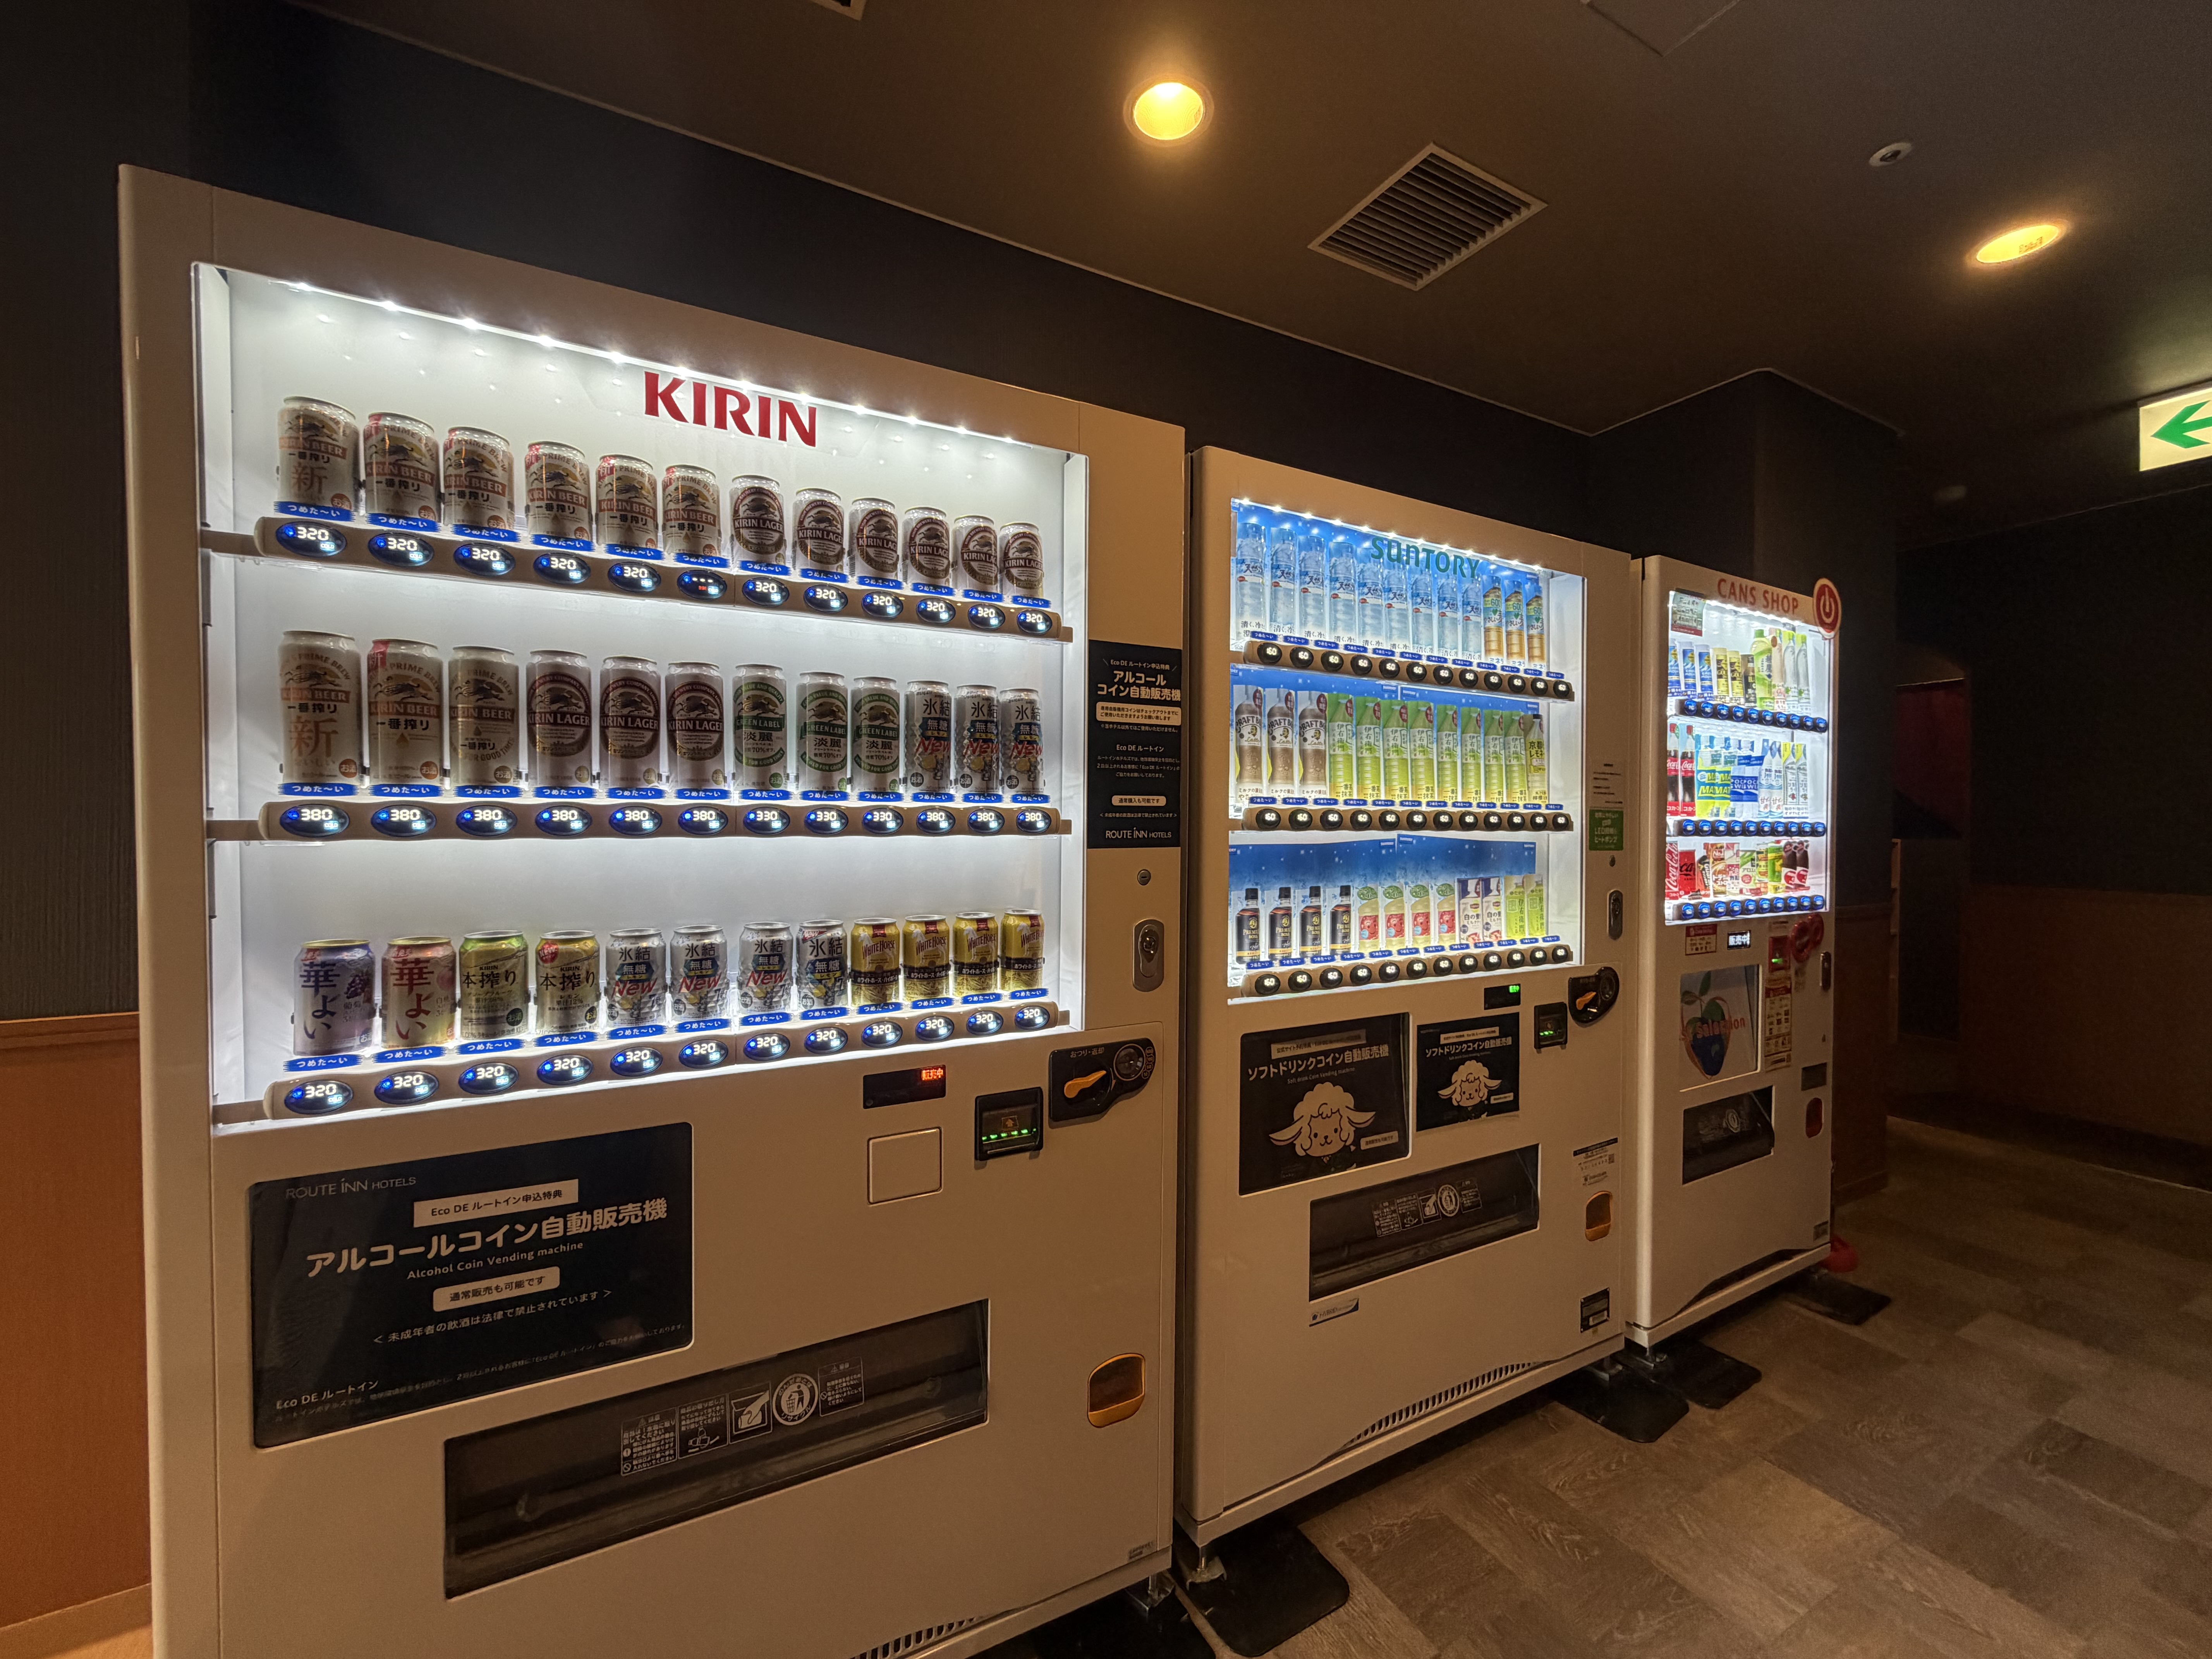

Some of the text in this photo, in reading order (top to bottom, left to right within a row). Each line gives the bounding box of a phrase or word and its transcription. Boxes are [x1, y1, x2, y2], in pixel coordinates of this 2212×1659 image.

[644, 371, 817, 447] KIRIN
[313, 441, 343, 456] BEER
[402, 467, 431, 483] BEER
[559, 493, 585, 505] BEER
[690, 513, 714, 523] BEER
[735, 518, 783, 532] KIRIN LAGER
[297, 527, 329, 541] 320
[388, 538, 417, 551] 320
[472, 548, 501, 560] 320
[551, 557, 577, 570] 320
[756, 582, 777, 594] 320
[873, 594, 892, 606] 320
[1717, 579, 1798, 615] CANS SHOP
[1027, 613, 1043, 623] 320
[1113, 671, 1166, 685] アルコール
[1097, 684, 1181, 701] コイン自動販売機
[407, 704, 437, 715] BEER
[483, 709, 511, 719] BEER
[923, 699, 950, 717] 氷結
[376, 719, 429, 730] 一番搾り
[557, 714, 589, 725] LAGER
[927, 720, 948, 730] 無糖
[744, 732, 773, 742] 淡麗
[814, 738, 841, 747] 淡麗
[915, 737, 951, 754] New
[301, 809, 333, 821] 380
[391, 809, 421, 821] 380
[552, 810, 578, 821] 380
[625, 810, 649, 821] 380
[757, 811, 780, 821] 330
[817, 811, 837, 822] 330
[927, 811, 946, 822] 380
[1025, 812, 1042, 822] 380
[809, 938, 843, 957] 氷結
[862, 940, 895, 959] WHITE HORSE
[915, 936, 946, 955] WHITE HORSE
[619, 946, 650, 962] 氷結
[623, 965, 646, 974] 無糖
[815, 960, 840, 972] 無糖
[463, 970, 516, 988] 本搾り
[540, 971, 595, 991] 本搾り
[611, 977, 658, 998] New
[976, 1013, 993, 1024] 320
[1024, 1009, 1040, 1018] 320
[871, 1024, 892, 1035] 320
[757, 1036, 778, 1048] 320
[693, 1043, 716, 1055] 320
[554, 1057, 579, 1070] 320
[477, 1066, 503, 1079] 320
[394, 1074, 422, 1087] 320
[306, 1084, 337, 1097] 320
[285, 1184, 336, 1199] ROUTE
[372, 1177, 416, 1190] HOTELS
[431, 1190, 562, 1216] Eco DE ルートイン申込特典
[307, 1197, 668, 1277] アルコールコイン自動販売機
[407, 1242, 583, 1280] Alcohol Coin Vending machine
[450, 1276, 546, 1302] 通常販売も可能です
[301, 1392, 319, 1404] DE
[322, 1381, 379, 1400] ルートイン
